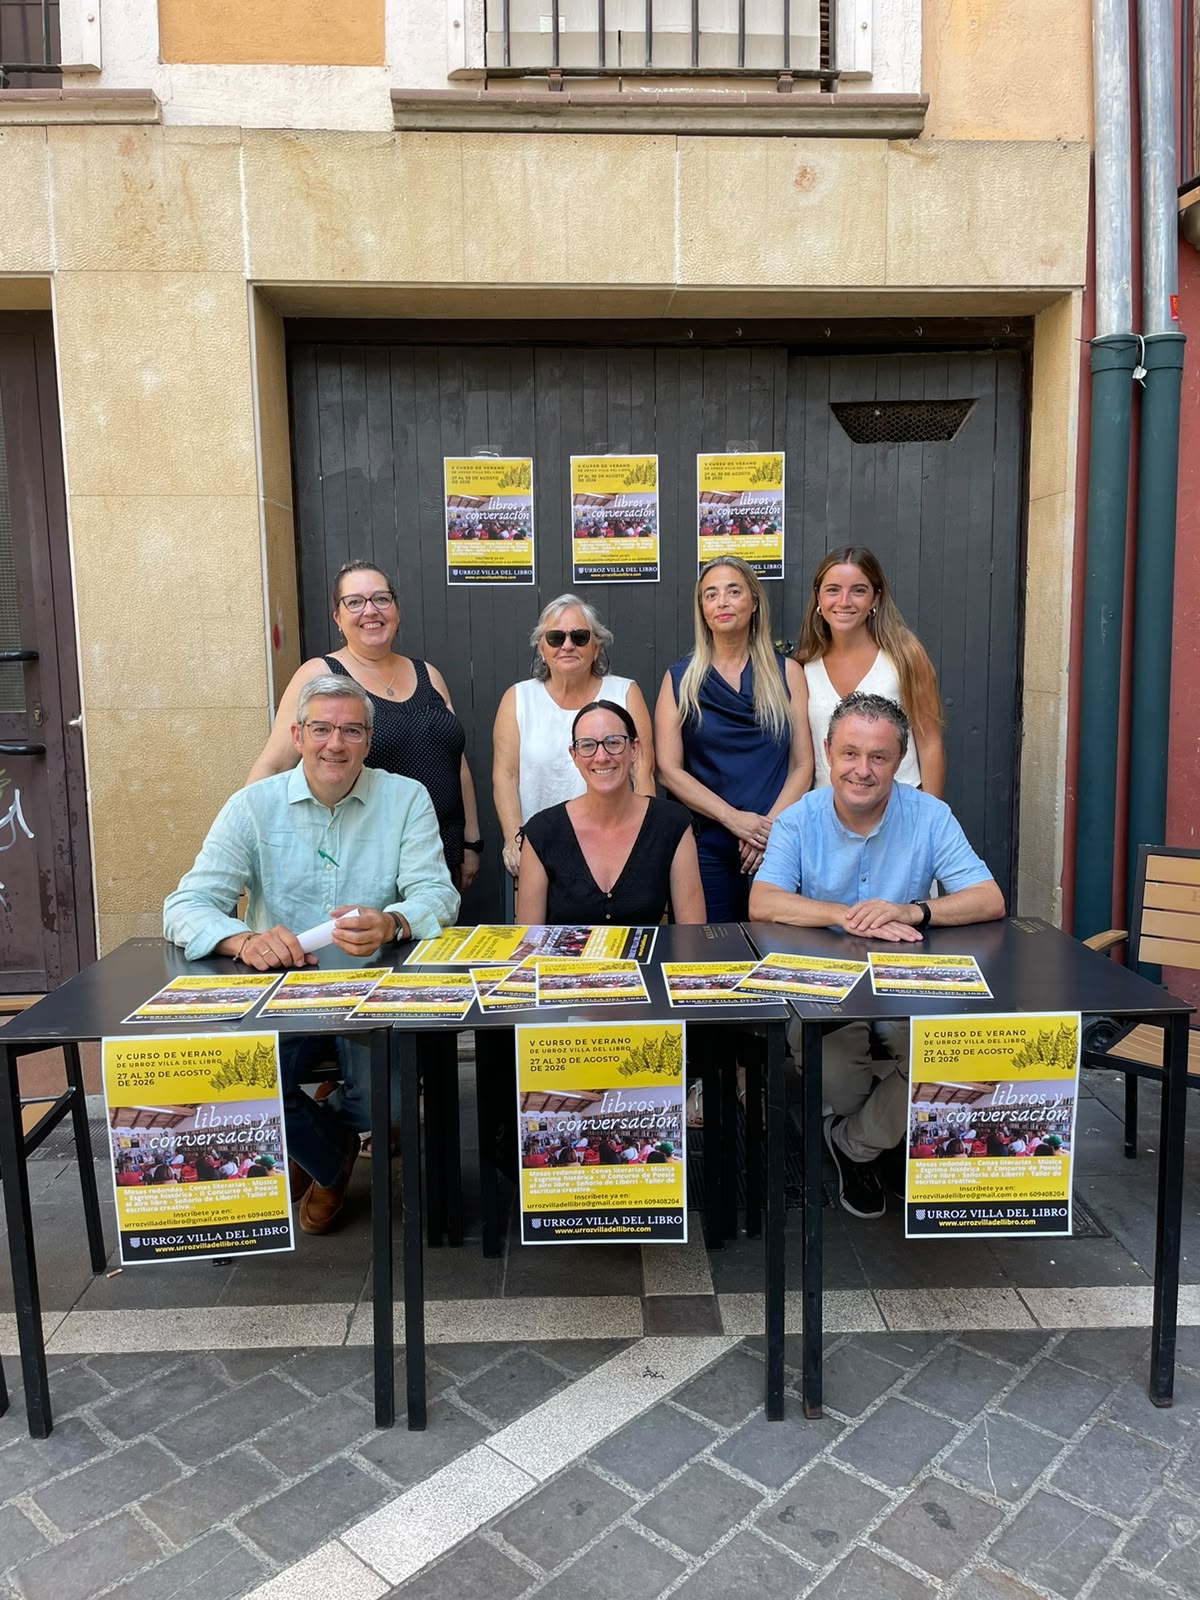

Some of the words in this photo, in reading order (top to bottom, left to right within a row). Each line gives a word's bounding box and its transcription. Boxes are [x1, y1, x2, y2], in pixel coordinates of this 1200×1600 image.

[488, 497, 517, 510] libros
[519, 503, 526, 512] y
[614, 495, 642, 507] libros
[645, 500, 650, 510] y
[740, 492, 768, 505] libros
[771, 498, 777, 506] y
[181, 1050, 222, 1058] VERANO
[173, 1069, 211, 1077] AGOSTO
[991, 1084, 1046, 1106] libros
[1044, 1093, 1063, 1109] y
[600, 1092, 654, 1113] libros
[653, 1100, 671, 1117] y
[193, 1106, 252, 1129] libros
[250, 1113, 270, 1131] y
[130, 1194, 158, 1202] Esgrima
[207, 1188, 241, 1196] Concurso
[149, 1186, 182, 1194] redondas
[927, 1210, 967, 1220] URROZ
[969, 1209, 1004, 1219] VILLA
[1007, 1208, 1030, 1218] DEL
[1032, 1208, 1067, 1217] LIBRO
[543, 1218, 583, 1227] URROZ
[586, 1217, 619, 1226] VILLA
[622, 1216, 645, 1225] DEL
[648, 1216, 682, 1225] LIBRO
[939, 1218, 1036, 1227] www.urrozvilladellibro.com
[142, 1235, 184, 1247] URROZ
[187, 1233, 222, 1243] VILLA
[225, 1230, 249, 1239] DEL
[252, 1225, 289, 1237] LIBRO
[555, 1226, 651, 1234] www.urrozvilladellibro.com
[155, 1238, 257, 1253] www.urrozvilladellibro.com
